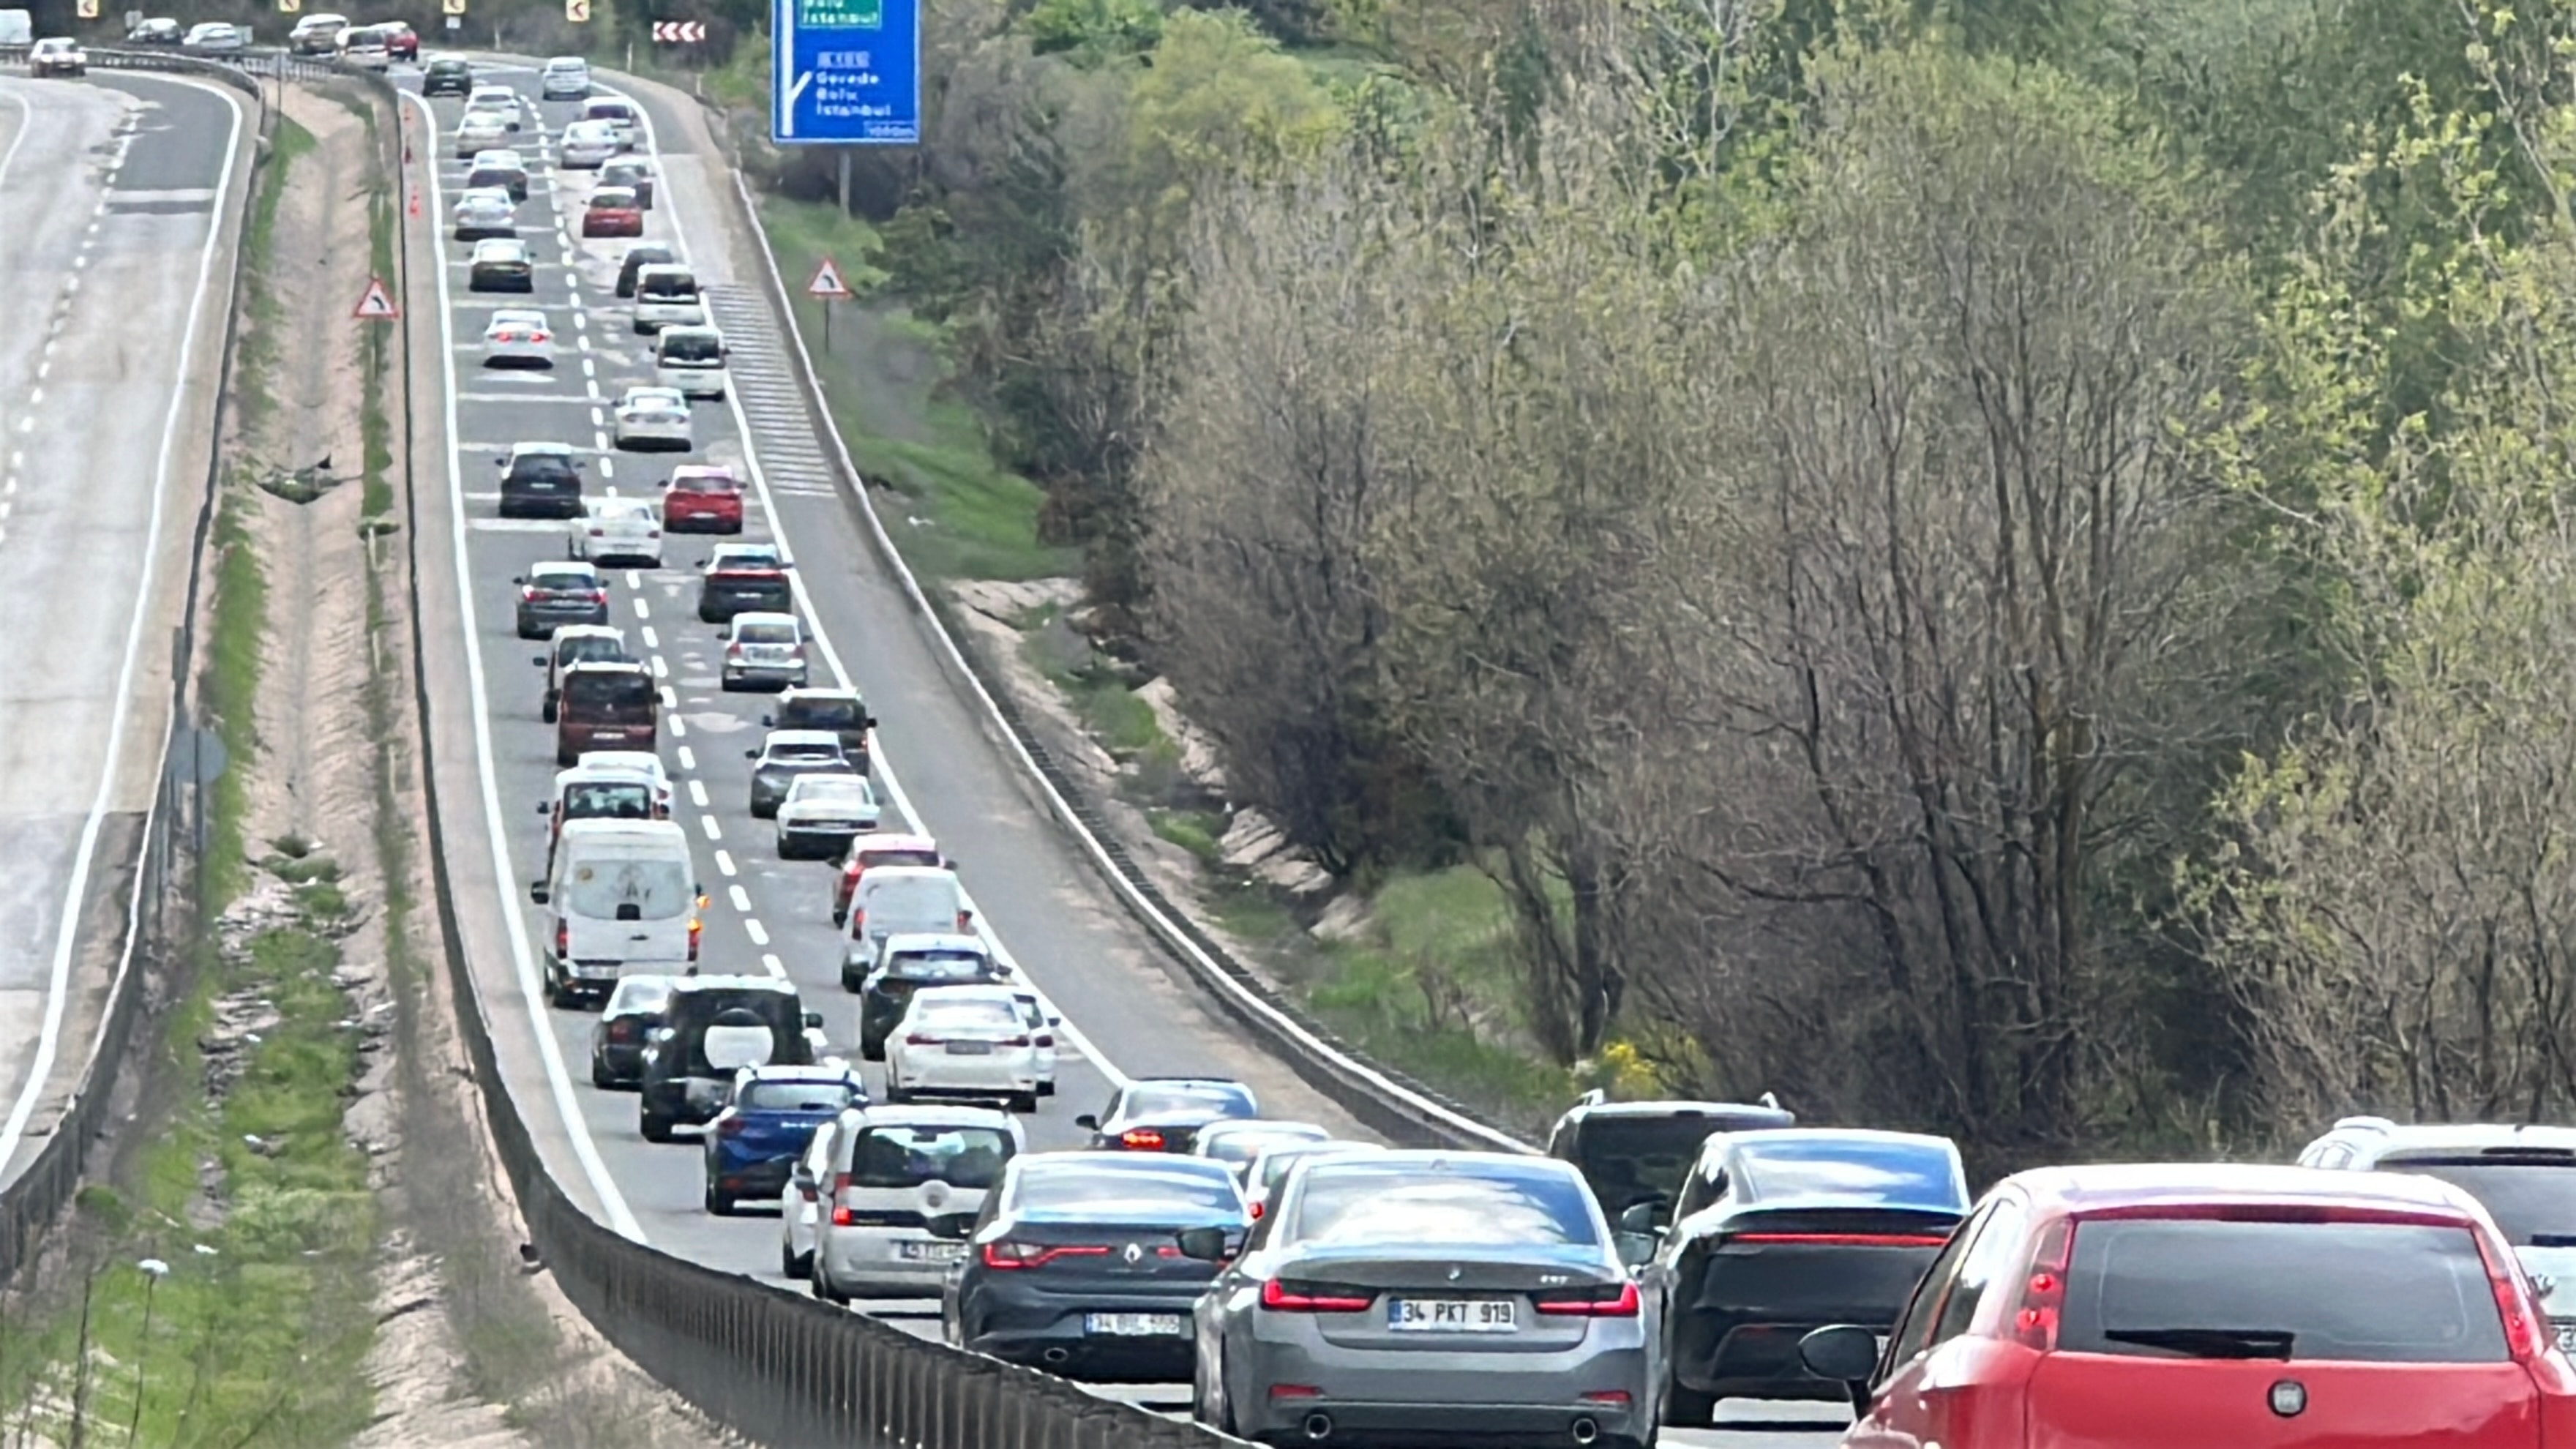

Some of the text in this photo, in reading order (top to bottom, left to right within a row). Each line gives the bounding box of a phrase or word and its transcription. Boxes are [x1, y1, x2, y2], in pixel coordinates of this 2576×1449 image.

[1404, 1303, 1511, 1323] 34 PKT 919
